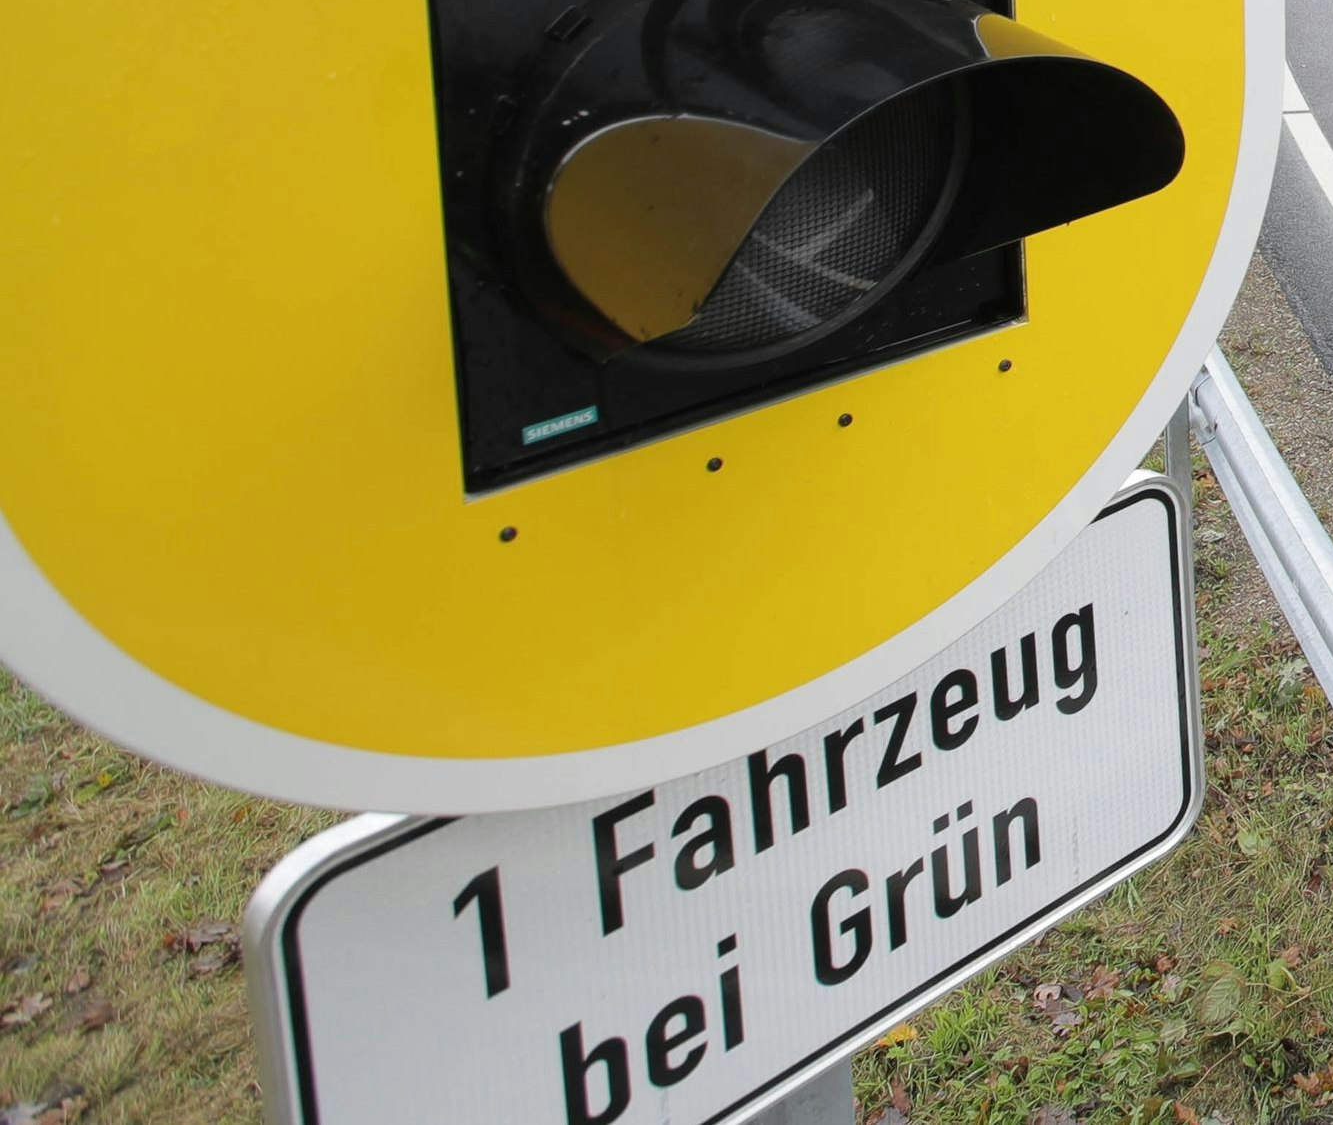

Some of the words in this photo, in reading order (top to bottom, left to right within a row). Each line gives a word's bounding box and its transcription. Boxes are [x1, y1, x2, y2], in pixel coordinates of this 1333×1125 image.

[526, 410, 594, 441] SIEMENS
[452, 866, 510, 1000] 1
[591, 602, 1098, 937] Fahrzeug
[559, 933, 744, 1125] bei
[810, 797, 1041, 986] Grün
